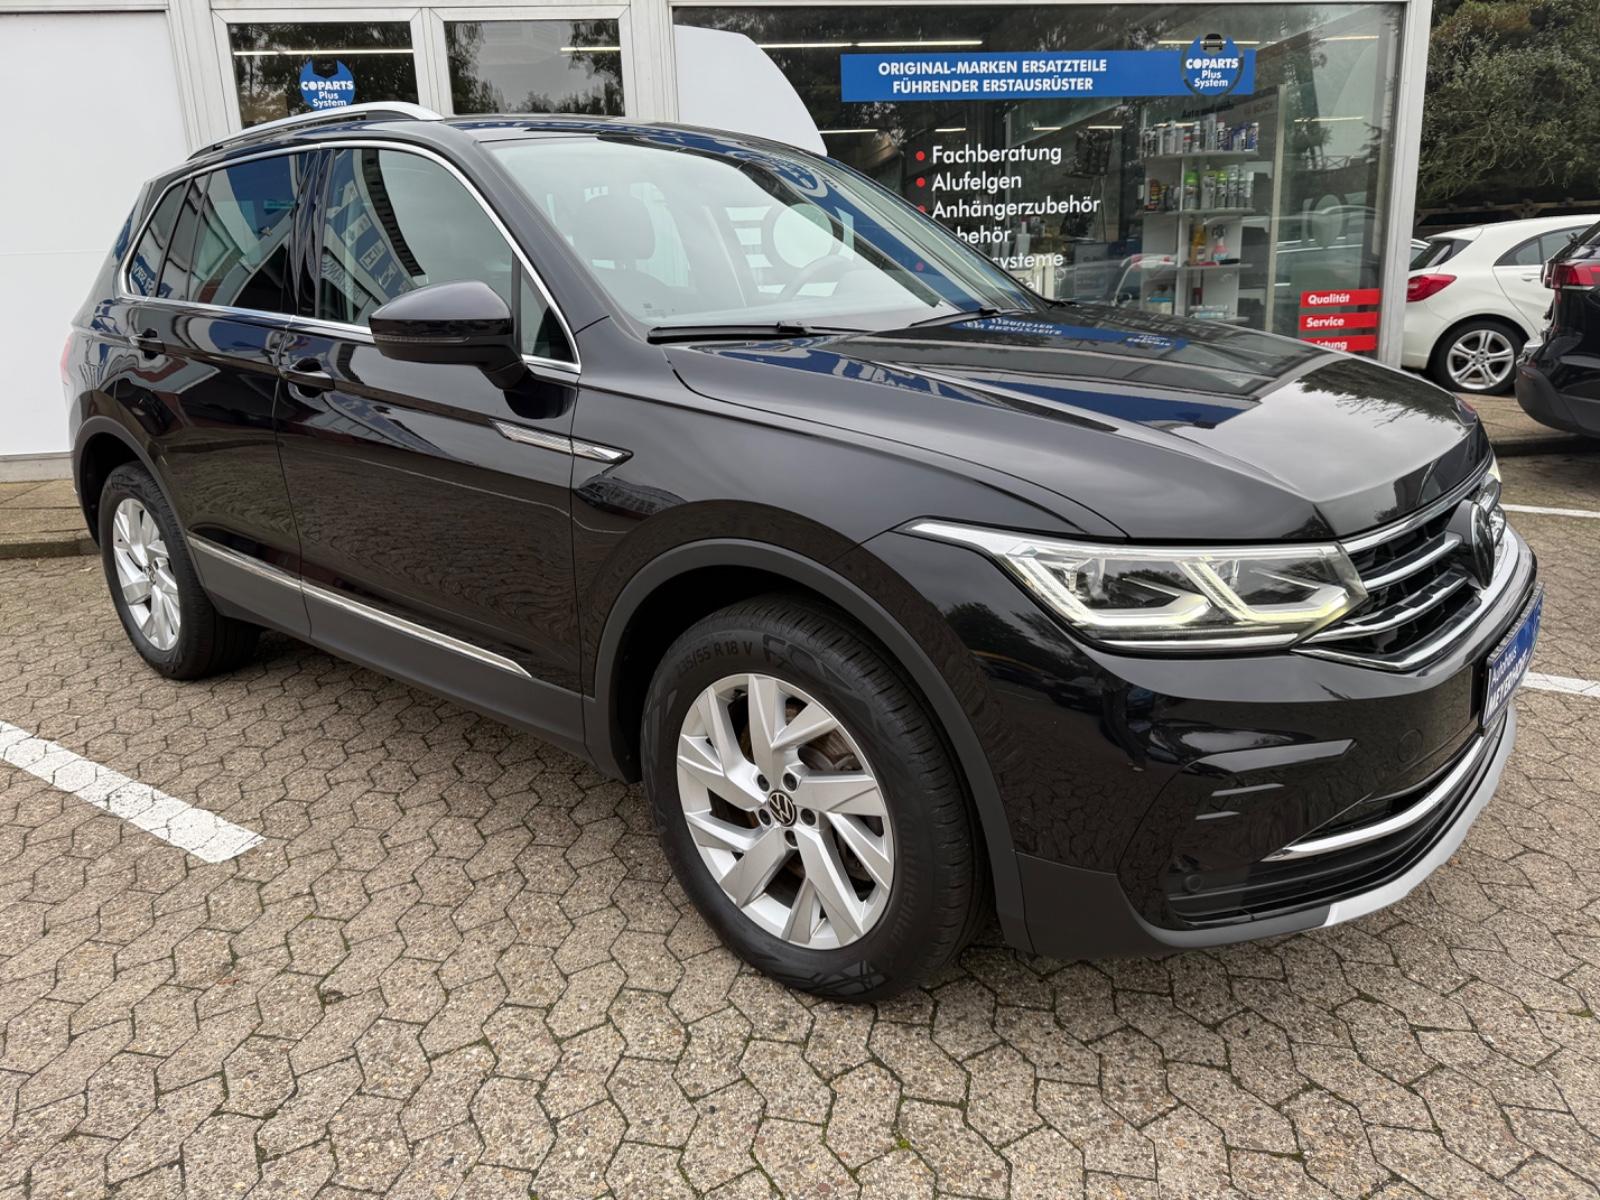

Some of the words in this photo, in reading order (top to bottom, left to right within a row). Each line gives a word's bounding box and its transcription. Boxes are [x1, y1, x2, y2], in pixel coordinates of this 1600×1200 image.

[878, 60, 1017, 76] ORIGINAL-MARKEN
[1022, 59, 1107, 73] ERSATZTEILE
[1185, 57, 1239, 69] COPARTS
[1201, 69, 1222, 79] Plus
[301, 80, 353, 91] COPARTS
[893, 77, 979, 94] FÜHRENDER
[983, 75, 1093, 92] ERSTAUSRÜSTER
[1193, 77, 1229, 90] System
[318, 91, 339, 100] Plus
[312, 98, 347, 108] System
[931, 144, 1063, 165] Fachberatung
[931, 171, 1022, 194] Alufelgen
[931, 194, 1101, 220] Anhängerzubehör
[956, 225, 1013, 244] behör
[1308, 293, 1350, 305] Qualität
[1306, 316, 1344, 328] Service
